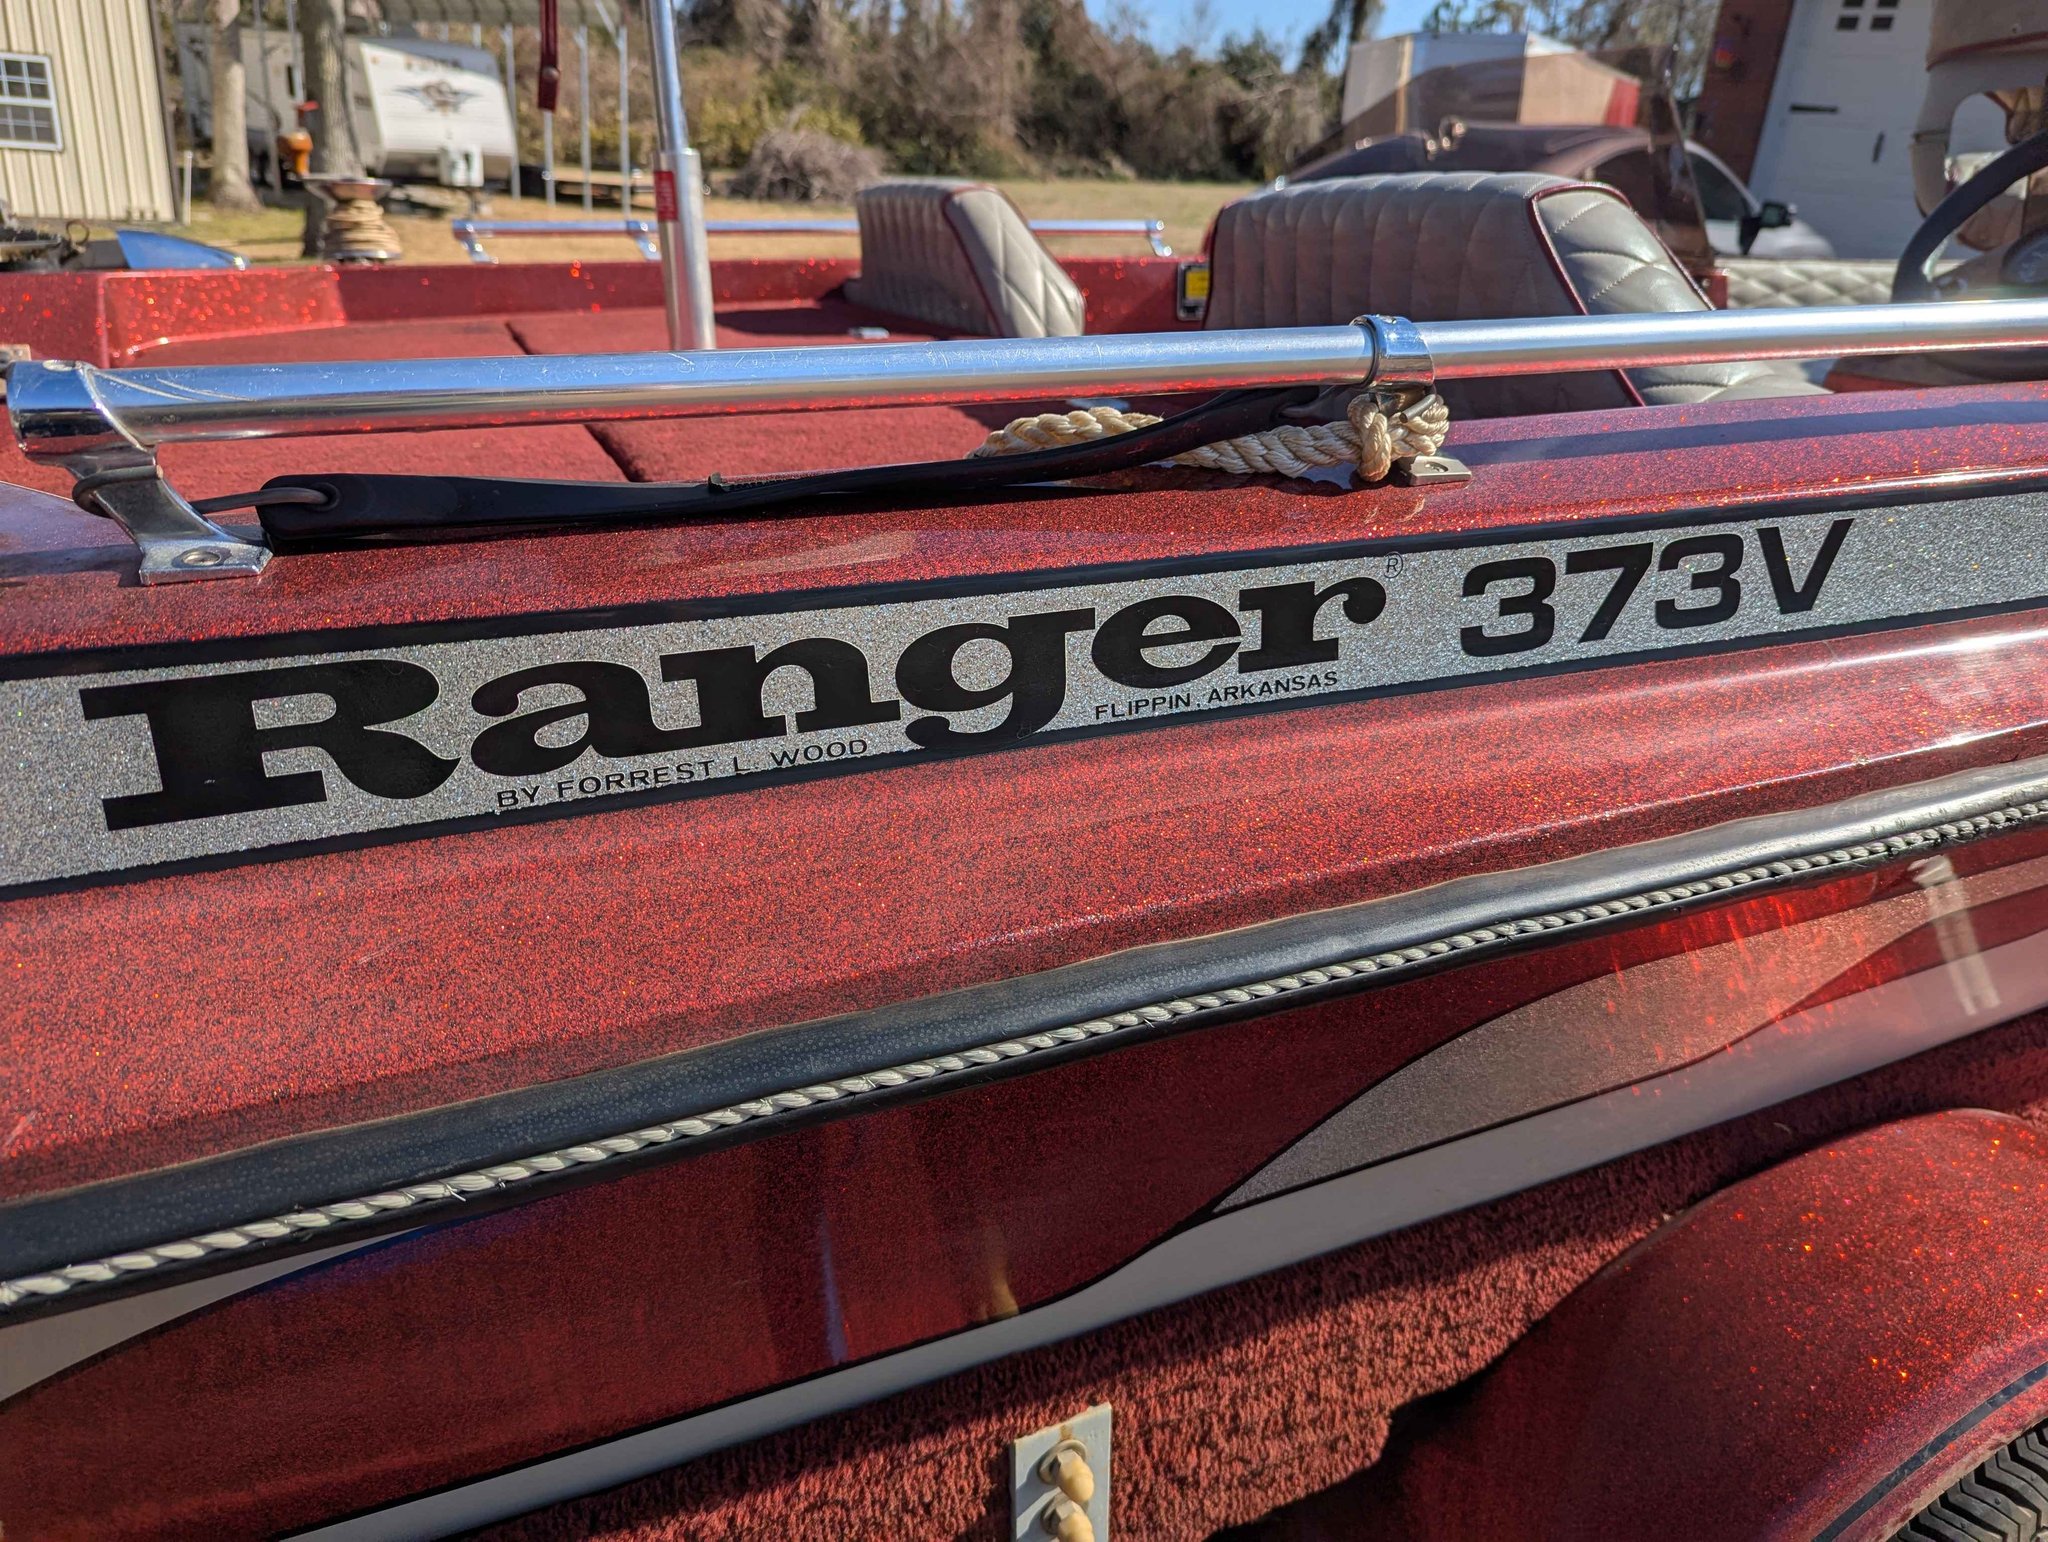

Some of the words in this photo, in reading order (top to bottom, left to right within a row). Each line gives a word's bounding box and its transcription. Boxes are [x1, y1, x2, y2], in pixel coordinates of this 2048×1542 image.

[79, 577, 1387, 831] Ranger
[1460, 518, 1856, 657] 373V
[1207, 670, 1339, 704] ARKANSAS
[497, 785, 541, 808] BY
[557, 759, 715, 799] FORREST
[770, 739, 868, 767] WOOD
